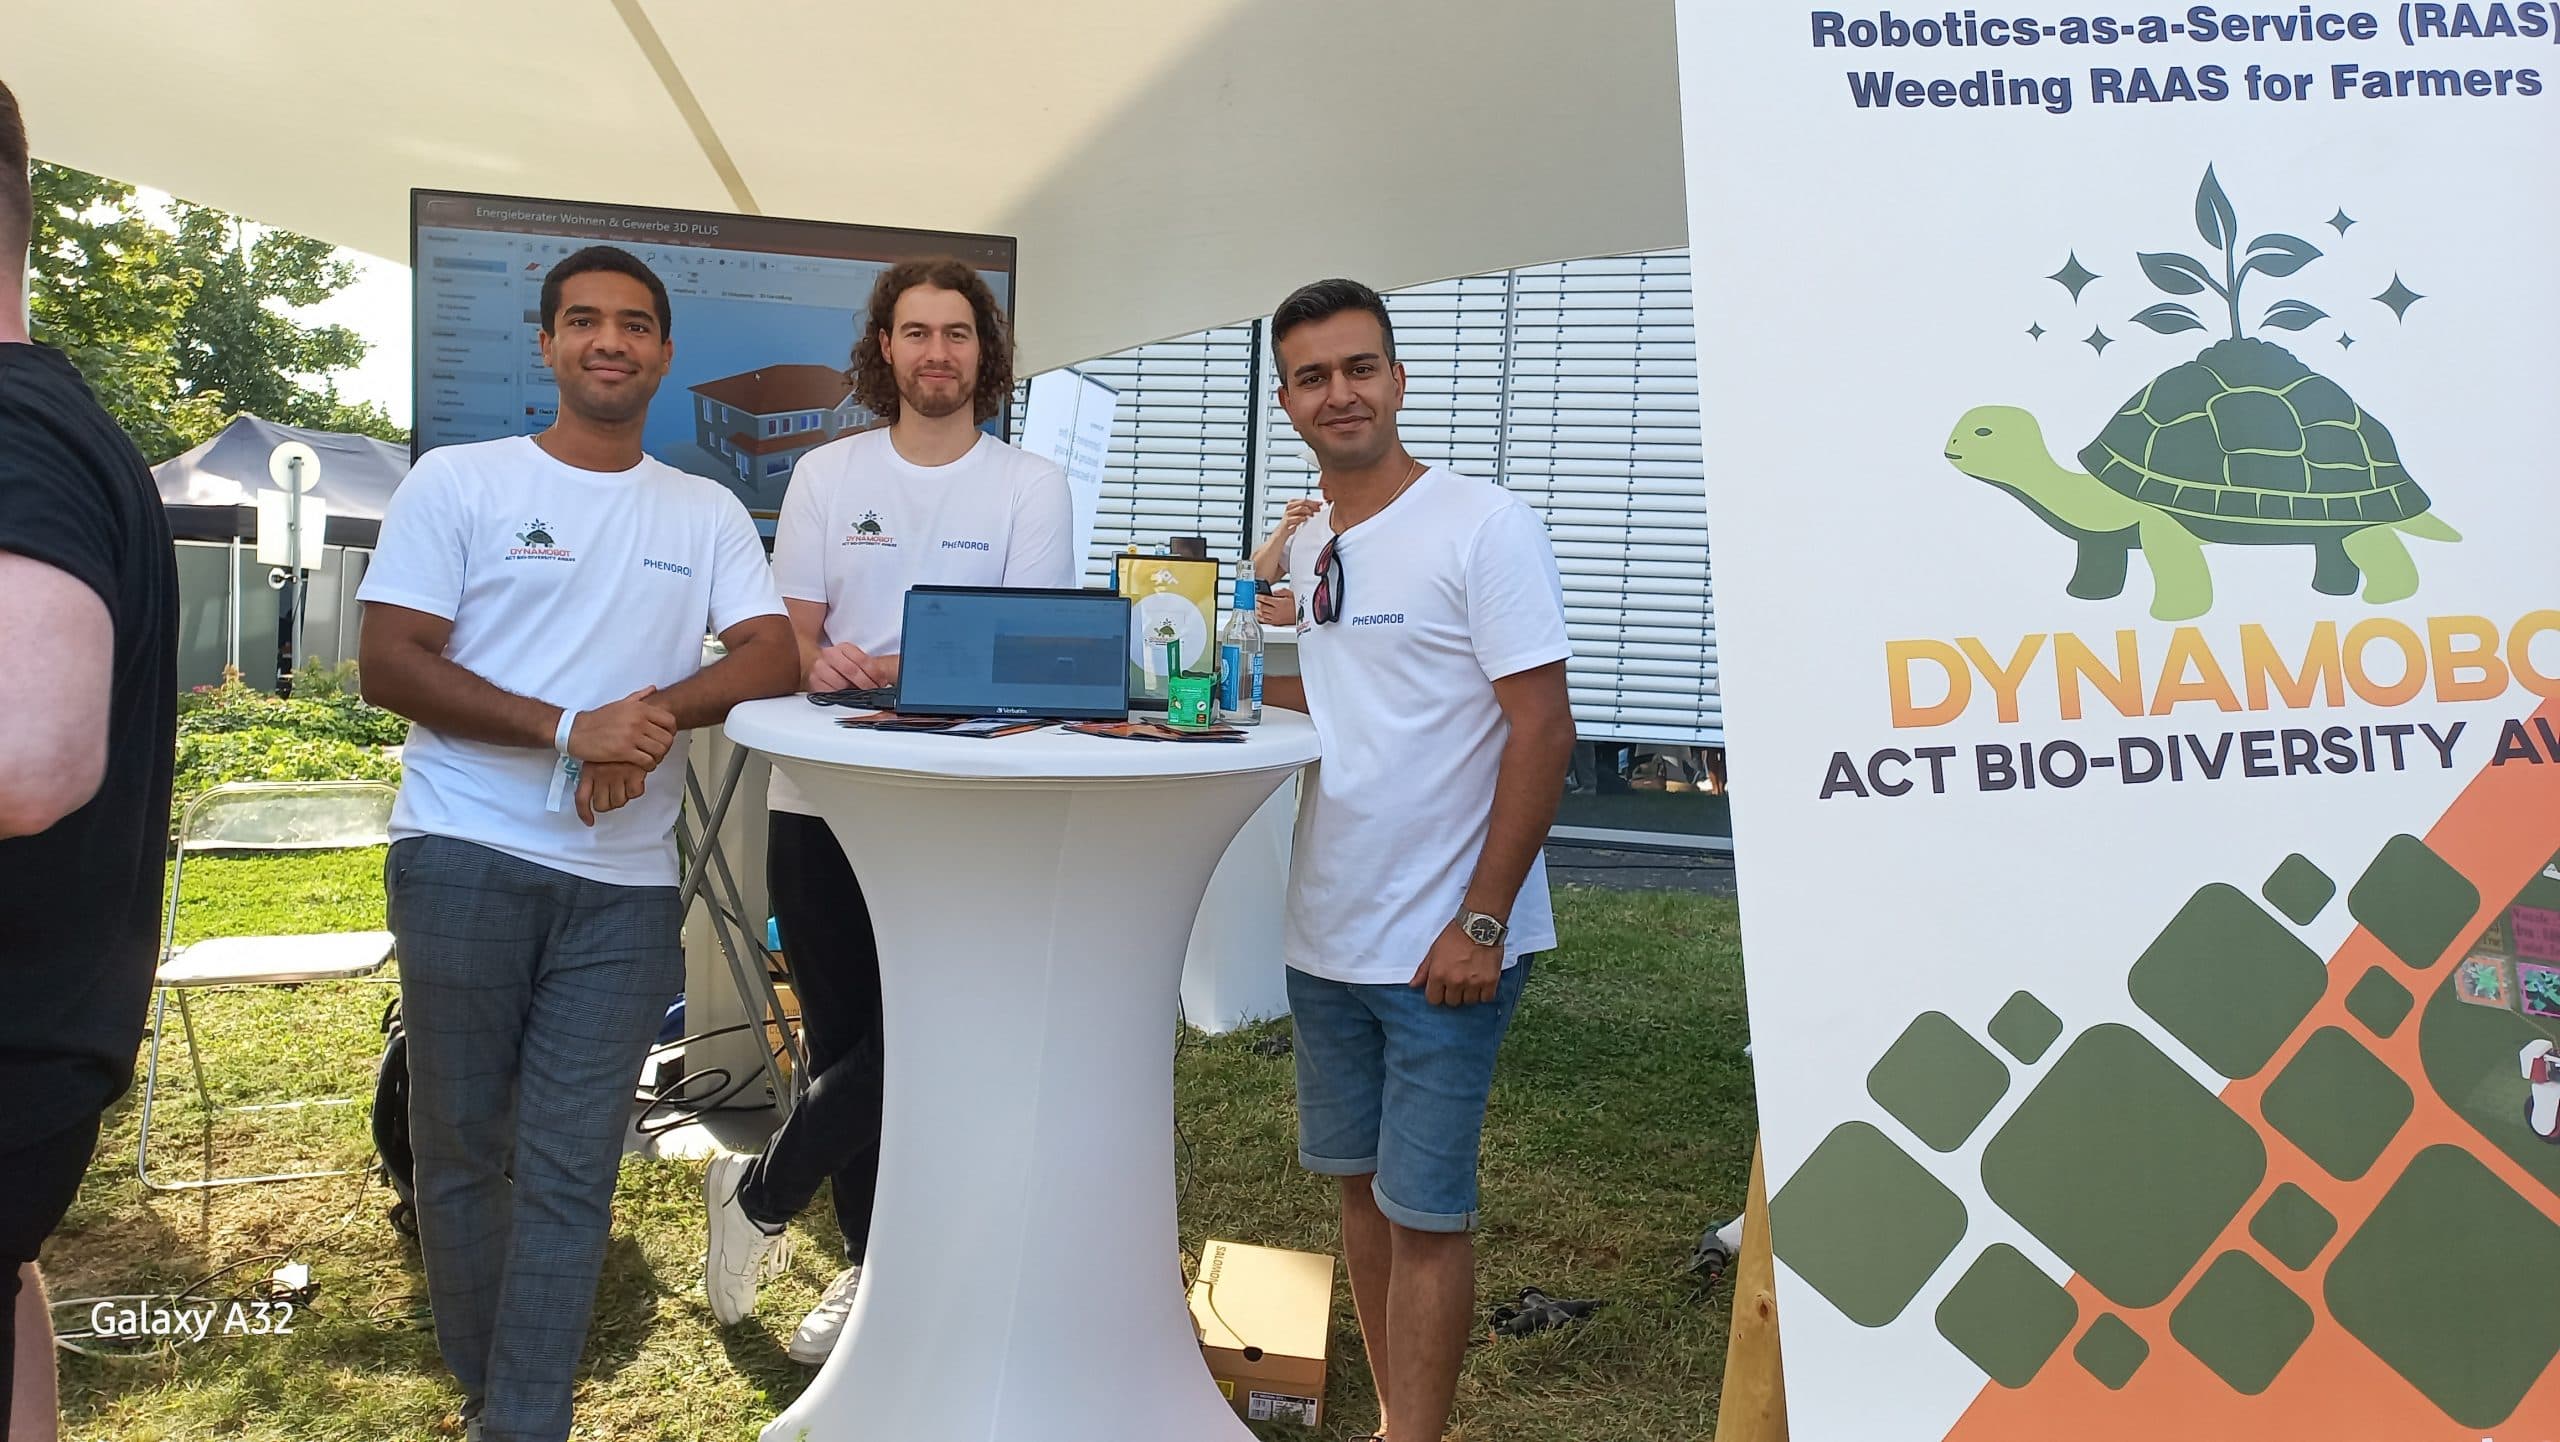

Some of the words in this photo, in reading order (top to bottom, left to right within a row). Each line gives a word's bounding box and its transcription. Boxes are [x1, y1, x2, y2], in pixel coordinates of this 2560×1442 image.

[1811, 3, 2377, 48] Robotics-as-a-Service
[1847, 68, 2072, 113] Weeding
[2090, 64, 2229, 104] RAAS
[2245, 65, 2312, 102] for
[2330, 62, 2542, 100] Farmers
[477, 207, 556, 223] Energieberater
[560, 213, 605, 226] Wohnen
[609, 217, 619, 228] &
[622, 218, 670, 232] Gewerbe
[672, 222, 688, 233] 3D
[691, 224, 719, 236] PLUS
[510, 548, 571, 557] DYNAMOBOT
[941, 540, 990, 551] PHENOROB
[643, 558, 692, 577] PHENORO
[1352, 613, 1404, 626] PHENOROB
[1819, 746, 1956, 799] ACT
[1975, 721, 2466, 792] BIO-DIVERSITY
[1208, 1245, 1226, 1285] SALOMON
